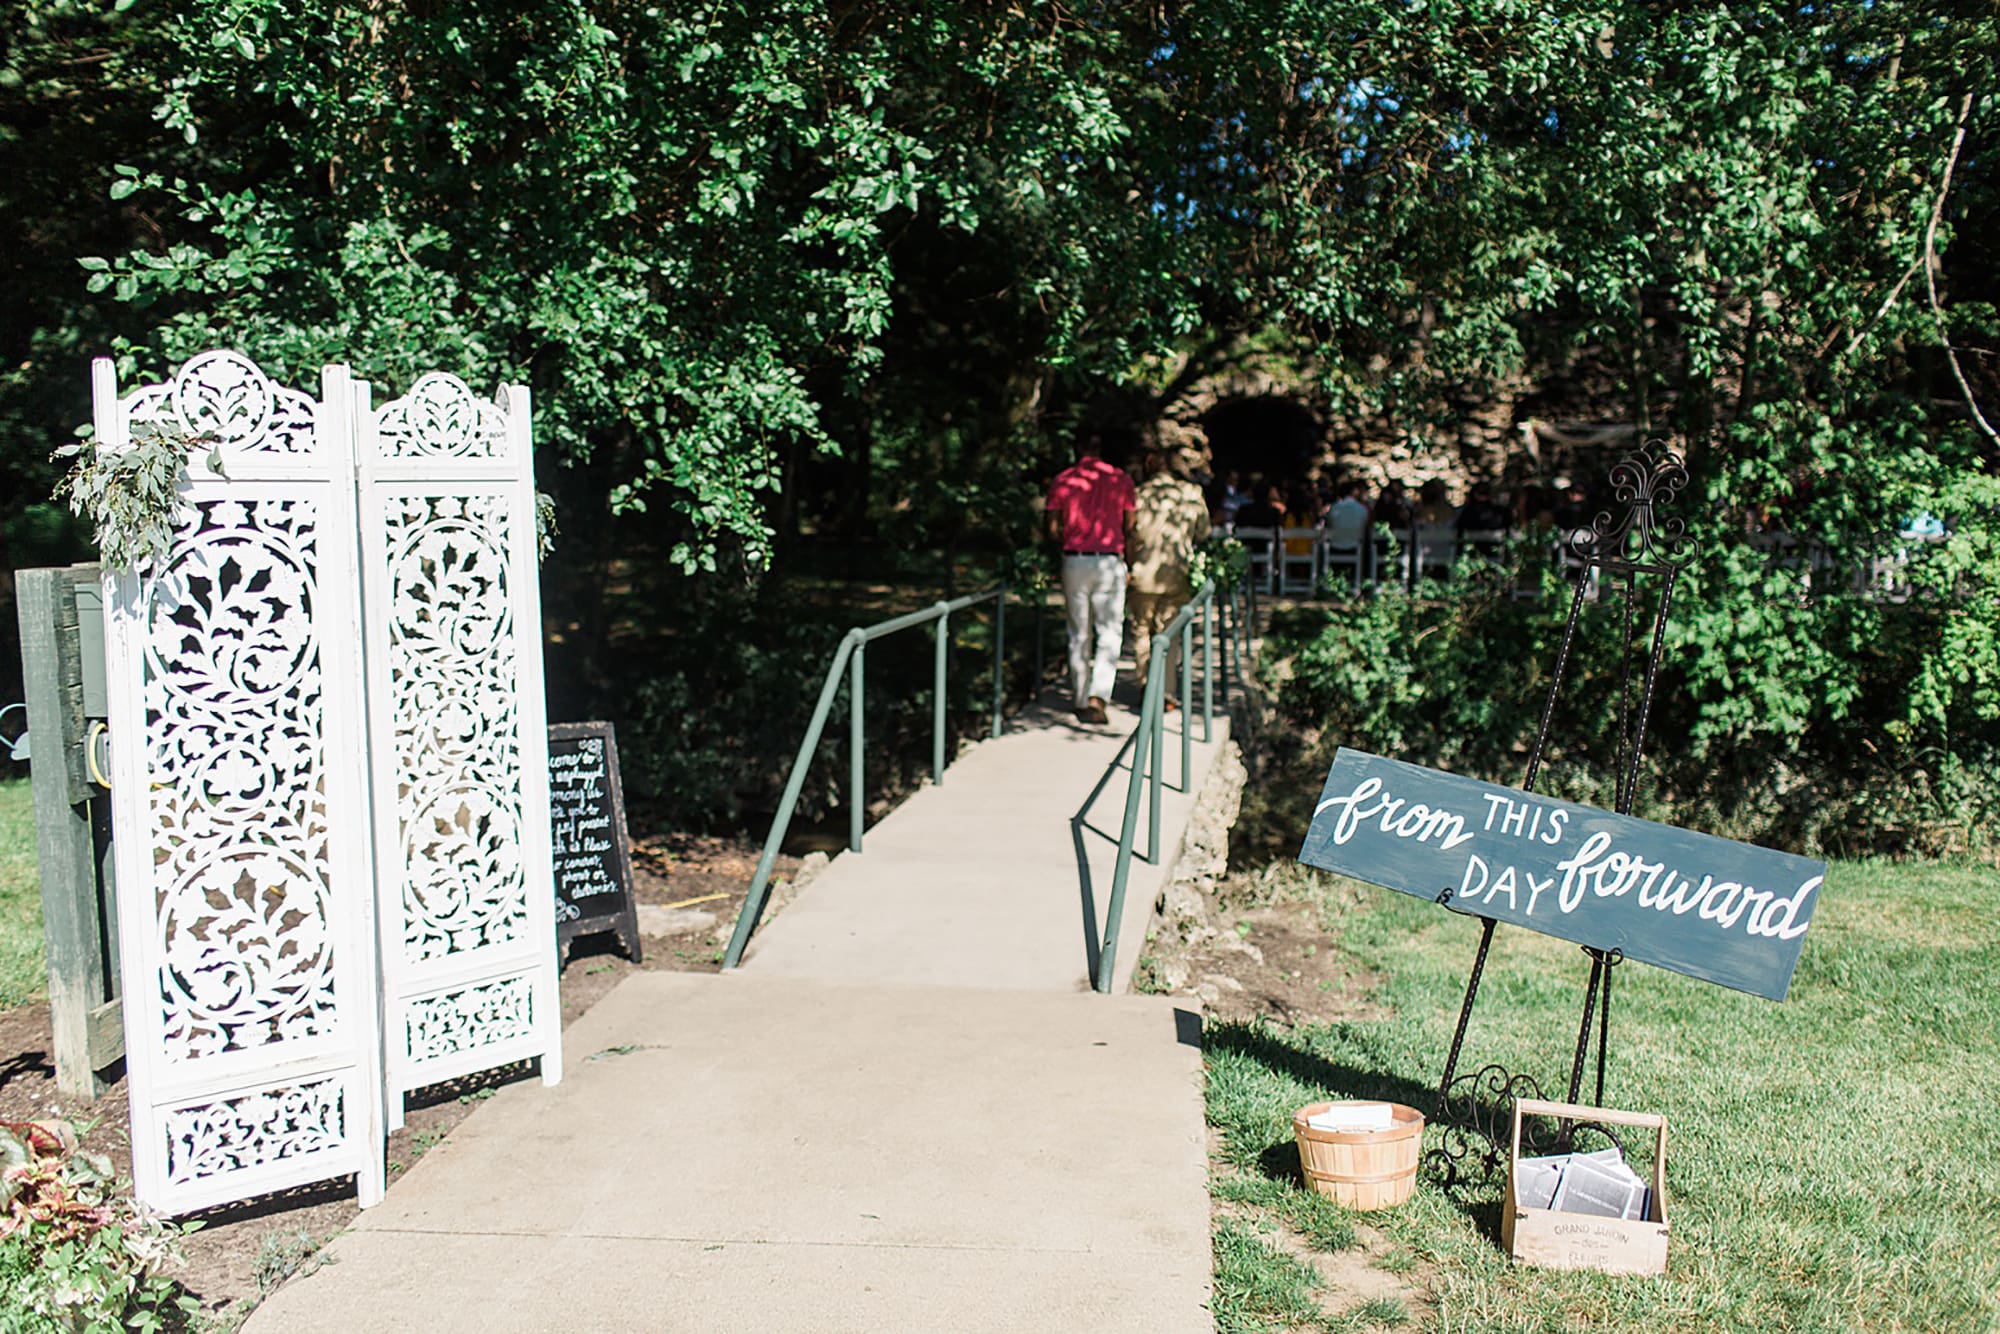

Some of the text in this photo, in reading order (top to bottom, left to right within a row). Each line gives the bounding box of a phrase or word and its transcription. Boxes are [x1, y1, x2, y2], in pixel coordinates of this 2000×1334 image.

[549, 752, 582, 768] come
[1313, 777, 1570, 850] from THIS
[1459, 831, 1824, 939] DAY forward
[1554, 1224, 1590, 1235] GRAND
